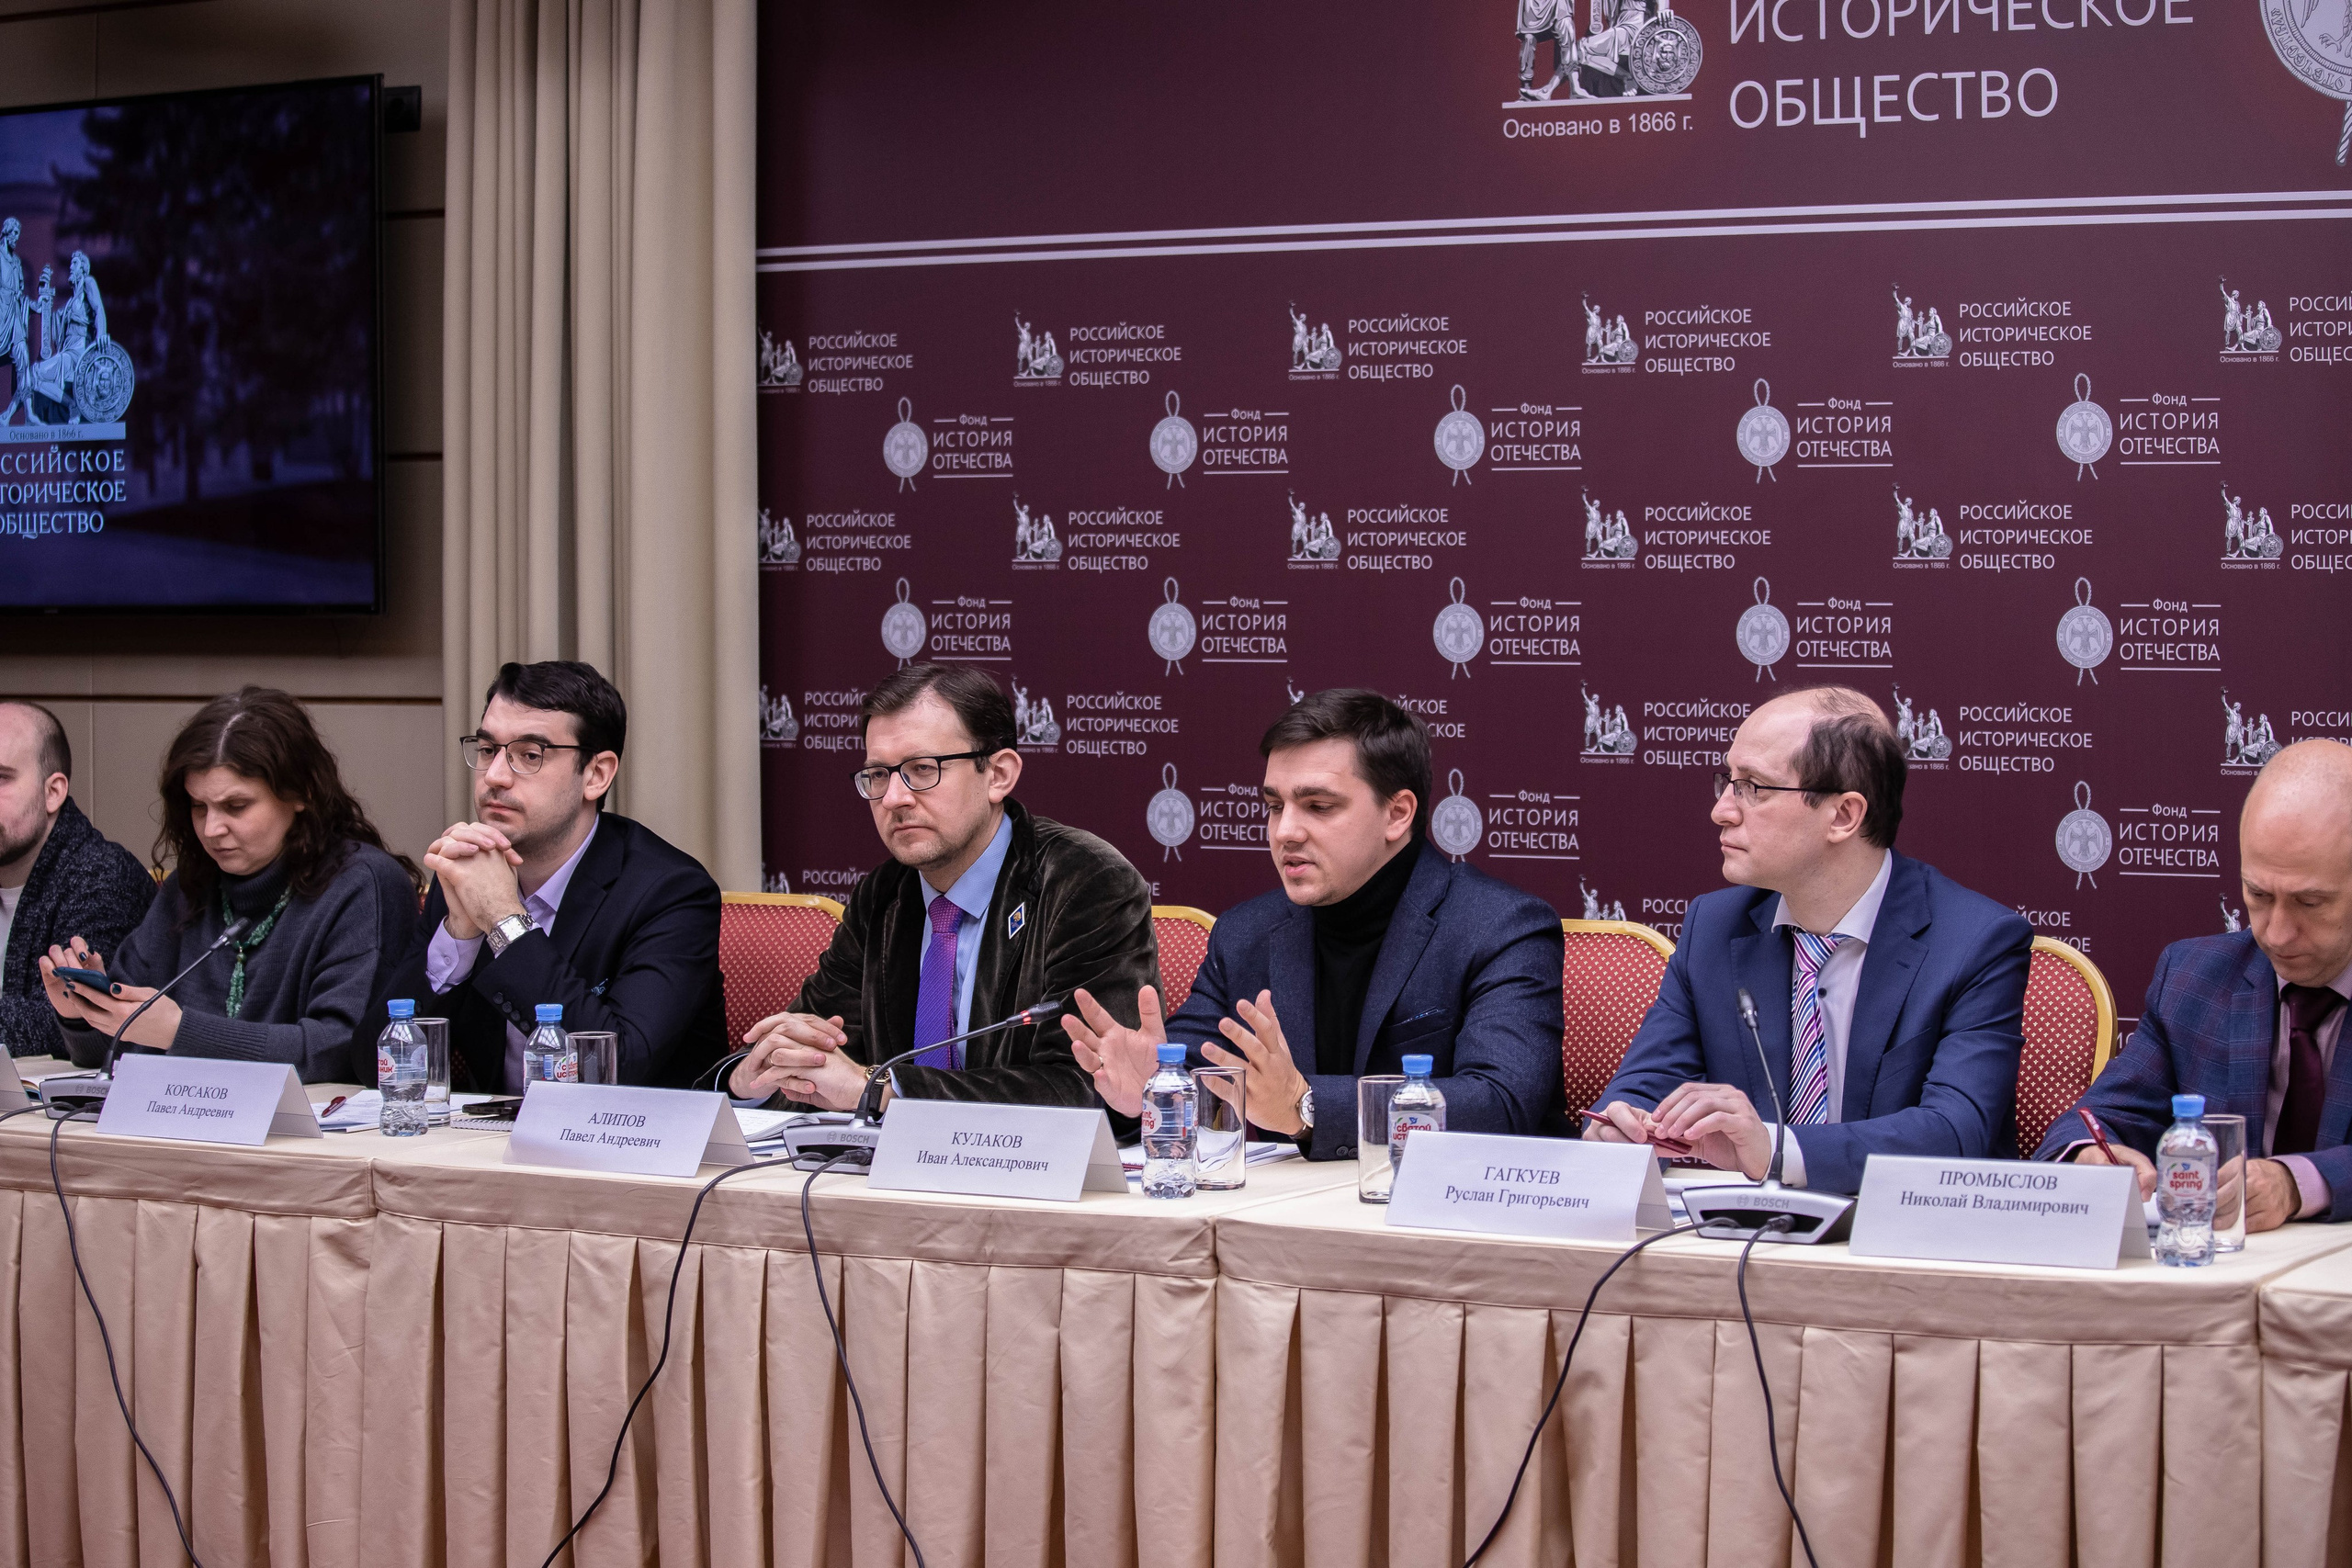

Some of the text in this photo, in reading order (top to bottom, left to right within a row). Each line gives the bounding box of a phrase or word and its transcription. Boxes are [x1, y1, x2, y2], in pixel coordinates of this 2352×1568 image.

[1730, 68, 2057, 138] ОБЩЕСТВО
[1503, 111, 1692, 138] Основано в 1866 г.
[1960, 298, 2071, 318] РОССИЙСКОЕ
[2290, 297, 2352, 311] РОССИ
[1349, 313, 1449, 333] РОССИЙСКОЕ
[1645, 305, 1751, 325] РОССИЙСКОЕ
[1070, 322, 1164, 341] РОССИЙСКОЕ
[1960, 326, 2092, 342] ИСТОРИЧЕСКОЕ
[2290, 321, 2352, 336] ИСТОР
[809, 331, 897, 349] РОССИЙСКОЕ
[1349, 340, 1467, 355] ИСТОРИЧЕСКОЕ
[1645, 333, 1770, 348] ИСТОРИЧЕСКОЕ
[809, 355, 912, 371] ИСТОРИЧЕСКОЕ
[1070, 347, 1182, 363] ИСТОРИЧЕСКОЕ
[1960, 351, 2053, 370] ОБЩЕСТВО
[1349, 364, 1433, 382] ОБЩЕСТВО
[1645, 356, 1735, 376] ОБЩЕСТВО
[808, 378, 883, 395] ОБЩЕСТВО
[1069, 370, 1149, 389] ОБЩЕСТВО
[1828, 398, 1861, 411] Фонд
[2153, 393, 2187, 406] Фонд
[1231, 409, 1261, 421] Фонд
[1521, 402, 1552, 415] Фонд
[959, 414, 987, 426] Фонд
[1797, 416, 1891, 434] ИСТОРИЯ
[2120, 412, 2218, 430] ИСТОРИЯ
[59, 429, 76, 439] 1866
[1204, 425, 1287, 443] ИСТОРИЯ
[1491, 421, 1580, 438] ИСТОРИЯ
[933, 431, 1012, 447] ИСТОРИЯ
[2120, 437, 2220, 455] ОТЕЧЕСТВА
[1203, 448, 1288, 465] ОТЕЧЕСТВА
[1491, 444, 1581, 461] ОТЕЧЕСТВА
[1797, 440, 1892, 457] ОТЕЧЕСТВА
[933, 453, 1012, 469] ОТЕЧЕСТВА
[807, 510, 895, 527] РОССИЙСКОЕ
[1069, 511, 1163, 525] РОССИЙСКОЕ
[1348, 504, 1448, 523] РОССИЙСКОЕ
[1645, 502, 1751, 521] РОССИЙСКОЕ
[1961, 500, 2072, 520] РОССИЙСКОЕ
[2291, 504, 2352, 519] РОССИ
[807, 535, 910, 549] ИСТОРИЧЕСКОЕ
[1069, 533, 1180, 547] ИСТОРИЧЕСКОЕ
[1348, 532, 1466, 546] ИСТОРИЧЕСКОЕ
[1645, 530, 1770, 545] ИСТОРИЧЕСКОЕ
[1961, 529, 2092, 544] ИСТОРИЧЕСКОЕ
[2291, 529, 2352, 544] ИСТОР
[807, 558, 881, 574] ОБЩЕСТВО
[1069, 556, 1148, 573] ОБЩЕСТВО
[1348, 555, 1432, 573] ОБЩЕСТВО
[1645, 555, 1735, 572] ОБЩЕСТВО
[1961, 554, 2054, 572] ОБЩЕСТВО
[957, 596, 986, 608] Фонд
[1230, 596, 1260, 609] Фонд
[1520, 597, 1551, 610] Фонд
[1828, 597, 1861, 611] Фонд
[2153, 598, 2188, 613] Фонд
[932, 614, 1010, 629] ИСТОРИЯ
[1203, 615, 1285, 630] ИСТОРИЯ
[1491, 615, 1579, 632] ИСТОРИЯ
[1797, 616, 1891, 633] ИСТОРИЯ
[2120, 618, 2218, 636] ИСТОРИЯ
[932, 635, 1011, 651] ОТЕЧЕСТВА
[1202, 637, 1286, 653] ОТЕЧЕСТВА
[1490, 638, 1580, 655] ОТЕЧЕСТВА
[1796, 640, 1892, 658] ОТЕЧЕСТВА
[2120, 643, 2220, 660] ОТЕЧЕСТВА
[1068, 695, 1161, 710] РОССИЙСКОЕ
[1645, 698, 1753, 720] РОССИЙСКОЕ
[1960, 703, 2072, 722] РОССИЙСКОЕ
[2291, 711, 2349, 727] РОССИ
[1067, 717, 1179, 733] ИСТОРИЧЕСКОЕ
[1960, 731, 2092, 748] ИСТОРИЧЕСКОЕ
[1067, 740, 1147, 758] ОБЩЕСТВО
[1960, 756, 2054, 774] ОБЩЕСТВО
[1228, 784, 1258, 796] Фонд
[1519, 790, 1550, 804] Фонд
[1489, 808, 1577, 826] ИСТОРИЯ
[2153, 804, 2187, 818] Фонд
[1488, 831, 1578, 850] ОТЕЧЕСТВА
[2120, 823, 2218, 841] ИСТОРИЯ
[2119, 848, 2219, 866] ОТЕЧЕСТВА
[164, 1084, 228, 1100] КОРСАКОВ
[147, 1101, 234, 1119] Павел Андреевич
[588, 1113, 646, 1127] АЛИПОВ
[560, 1129, 661, 1148] Павел Андреевич
[840, 1133, 870, 1145] BOSCH
[952, 1132, 1023, 1148] КУЛАКОВ
[917, 1151, 1048, 1172] Иван Александрович
[1485, 1167, 1560, 1184] ГАГКУЕВ
[1939, 1171, 2057, 1190] ПРОМЫСЛОВ
[2172, 1170, 2199, 1179] saint
[2169, 1179, 2203, 1190] spring
[1445, 1186, 1589, 1209] Руслан Григорьевич
[1753, 1198, 1790, 1210] BOSCH
[1901, 1191, 2088, 1216] Николай Владимирович
